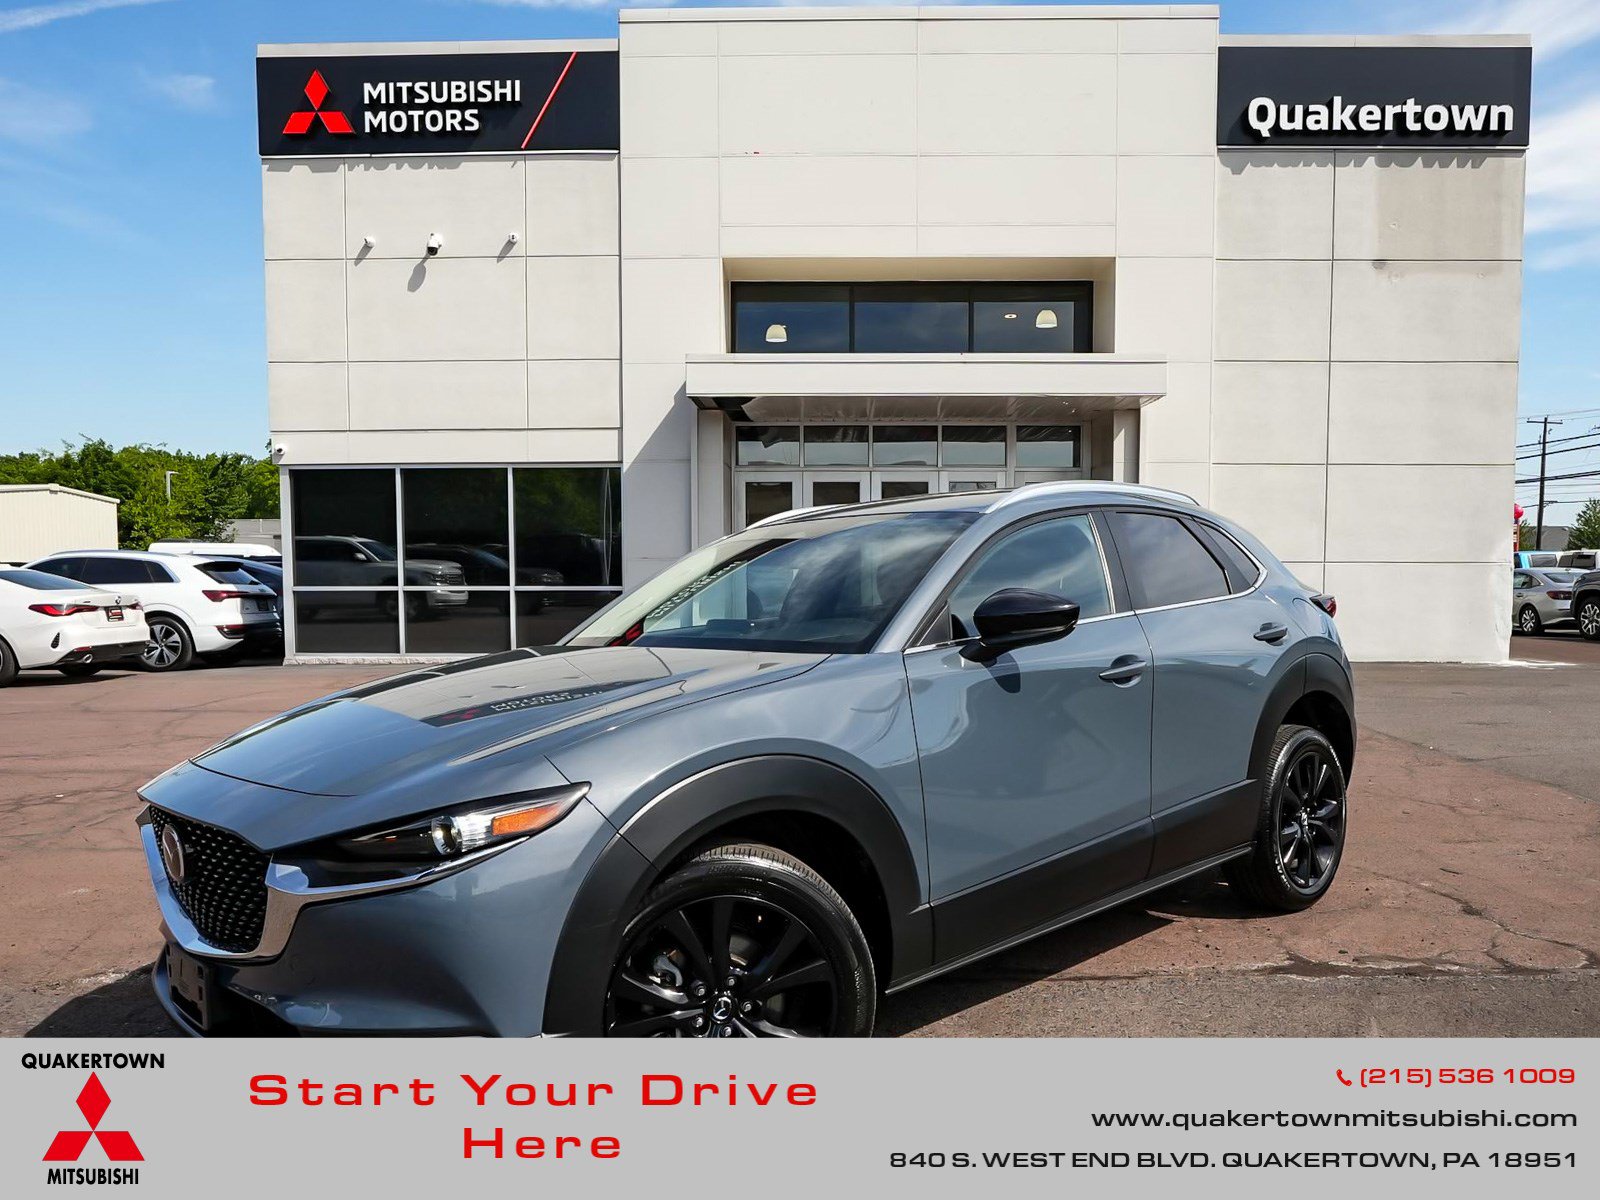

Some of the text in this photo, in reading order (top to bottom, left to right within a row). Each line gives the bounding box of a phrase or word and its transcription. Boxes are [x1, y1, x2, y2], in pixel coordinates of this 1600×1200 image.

[363, 79, 522, 104] MITSUBISHI
[364, 109, 481, 133] MOTORS
[1247, 95, 1514, 138] Quakertown
